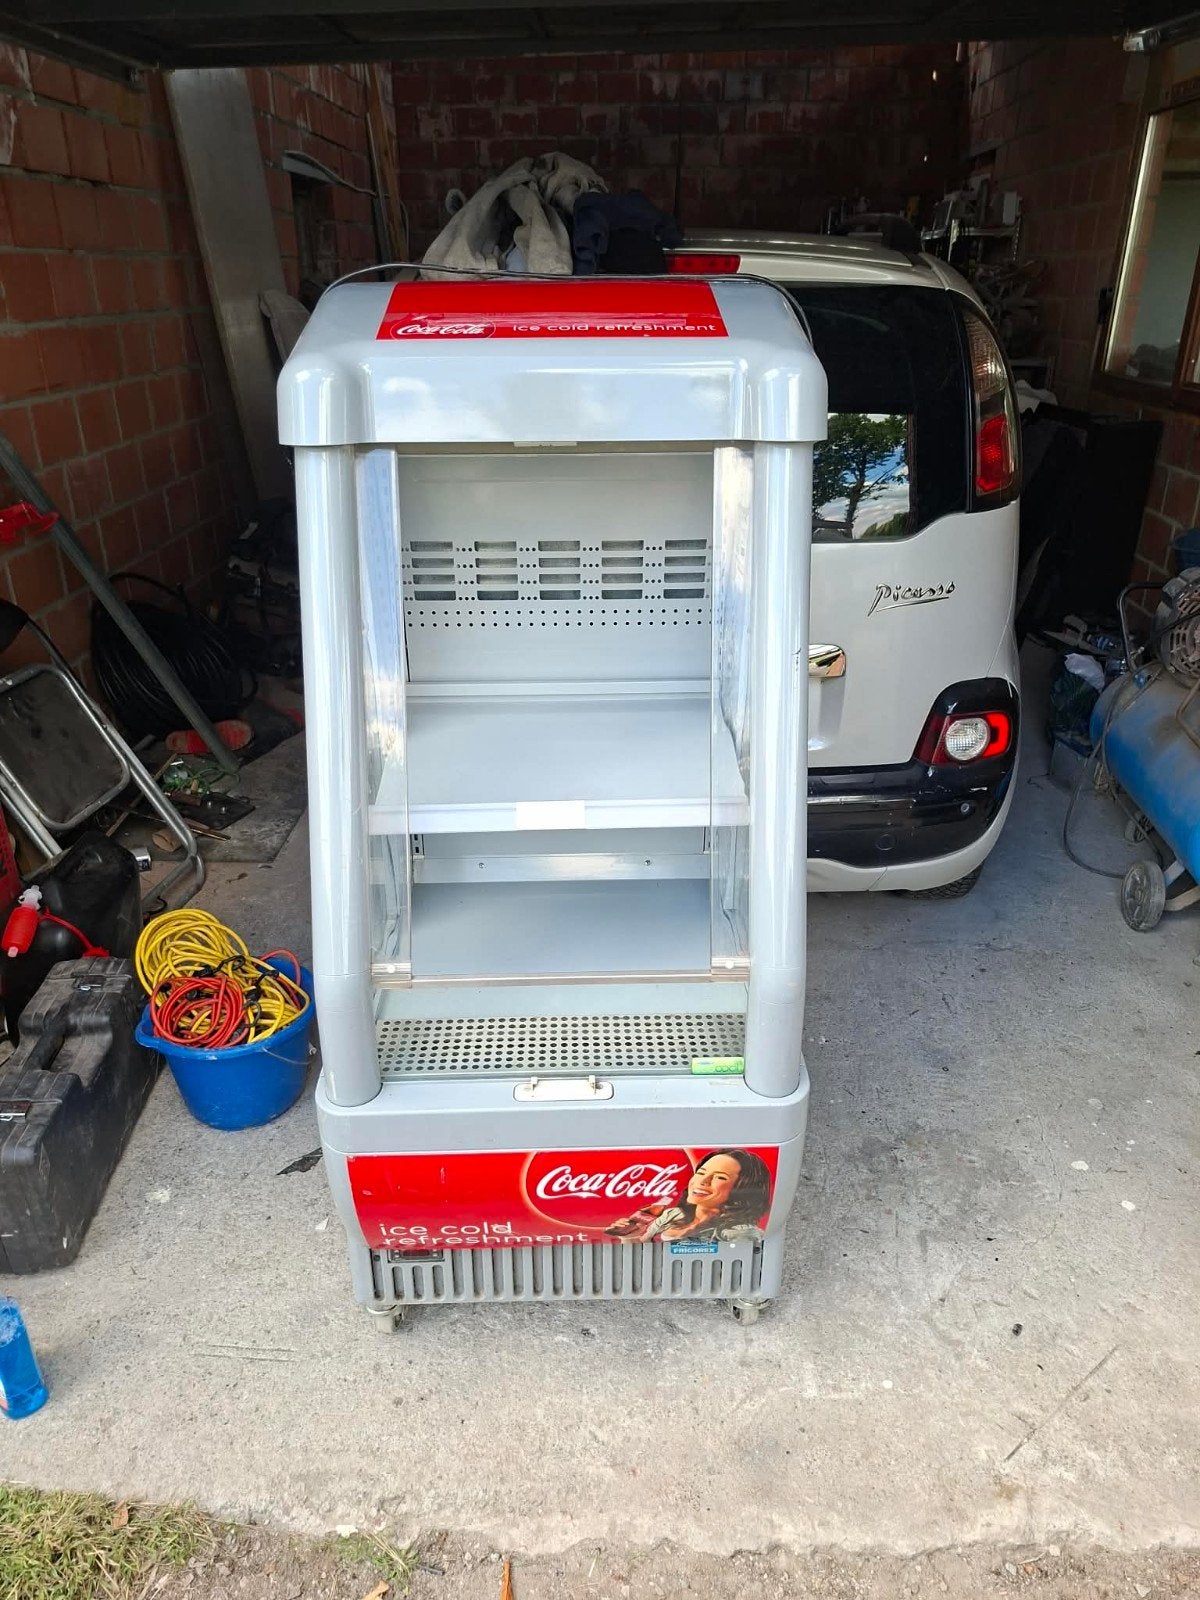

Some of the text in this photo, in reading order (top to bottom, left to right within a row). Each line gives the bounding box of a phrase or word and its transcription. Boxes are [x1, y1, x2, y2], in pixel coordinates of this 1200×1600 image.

[513, 324, 541, 332] ice
[547, 323, 589, 332] cold
[596, 323, 718, 332] refreshment
[867, 581, 956, 617] Picasso
[379, 1221, 512, 1236] ice cold
[383, 1232, 589, 1246] refreshment
